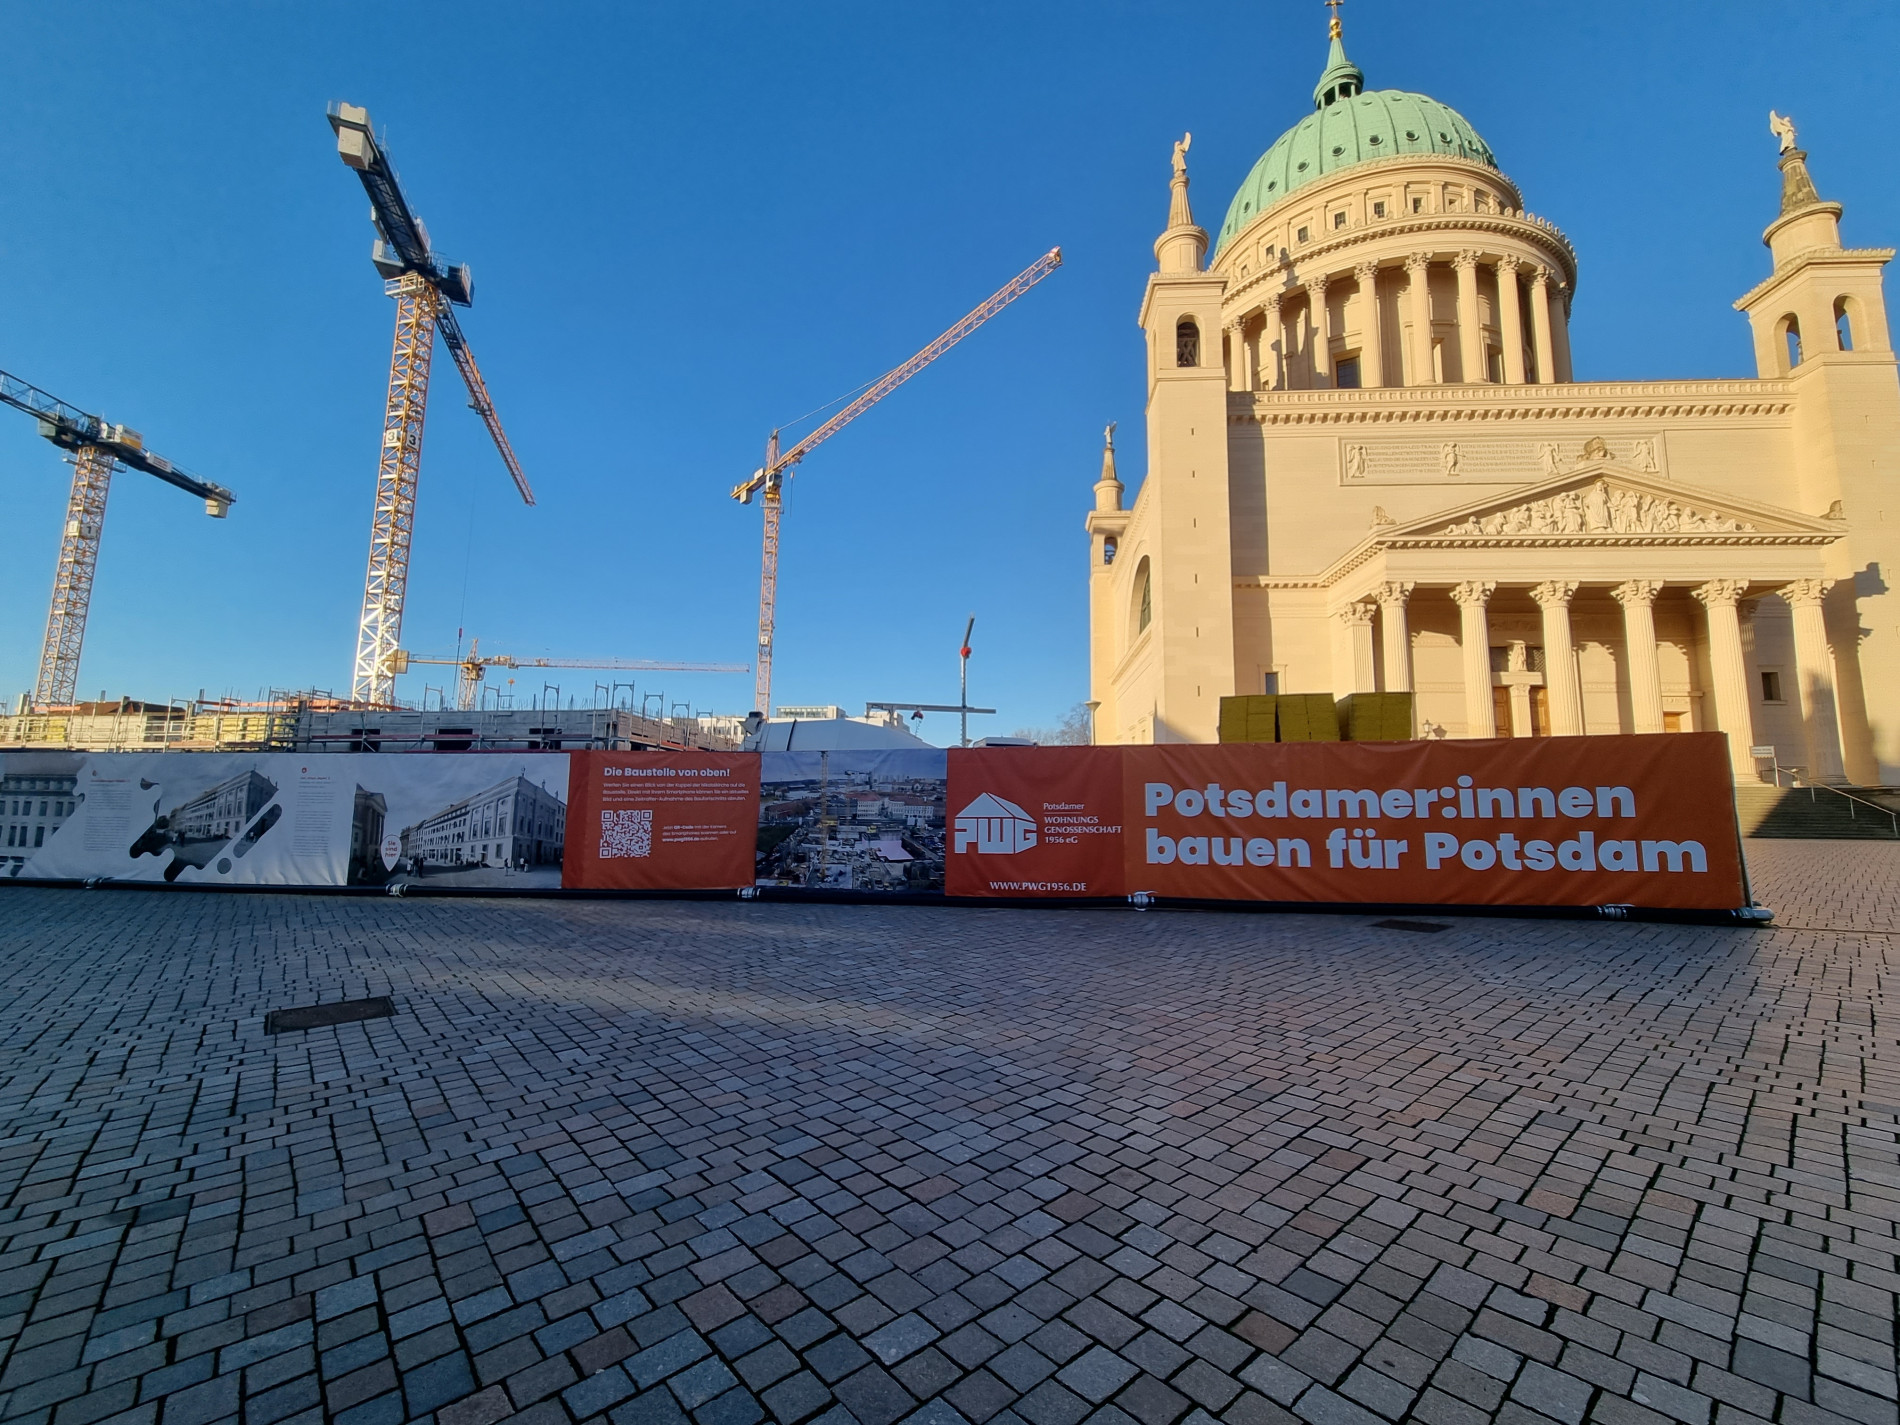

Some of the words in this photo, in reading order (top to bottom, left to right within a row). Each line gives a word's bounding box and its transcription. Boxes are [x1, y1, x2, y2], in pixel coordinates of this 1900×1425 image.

[388, 431, 395, 441] 3
[410, 434, 416, 445] 3
[604, 767, 622, 776] Die
[624, 768, 676, 776] Baustelle
[700, 768, 730, 776] oben!
[1145, 775, 1636, 818] Potsdamer:innen
[954, 818, 1037, 854] PWG
[1146, 828, 1311, 867] bauen
[1326, 828, 1408, 870] für
[1424, 831, 1708, 872] Potsdam
[990, 881, 1087, 892] WWW.PWG1956.DE
